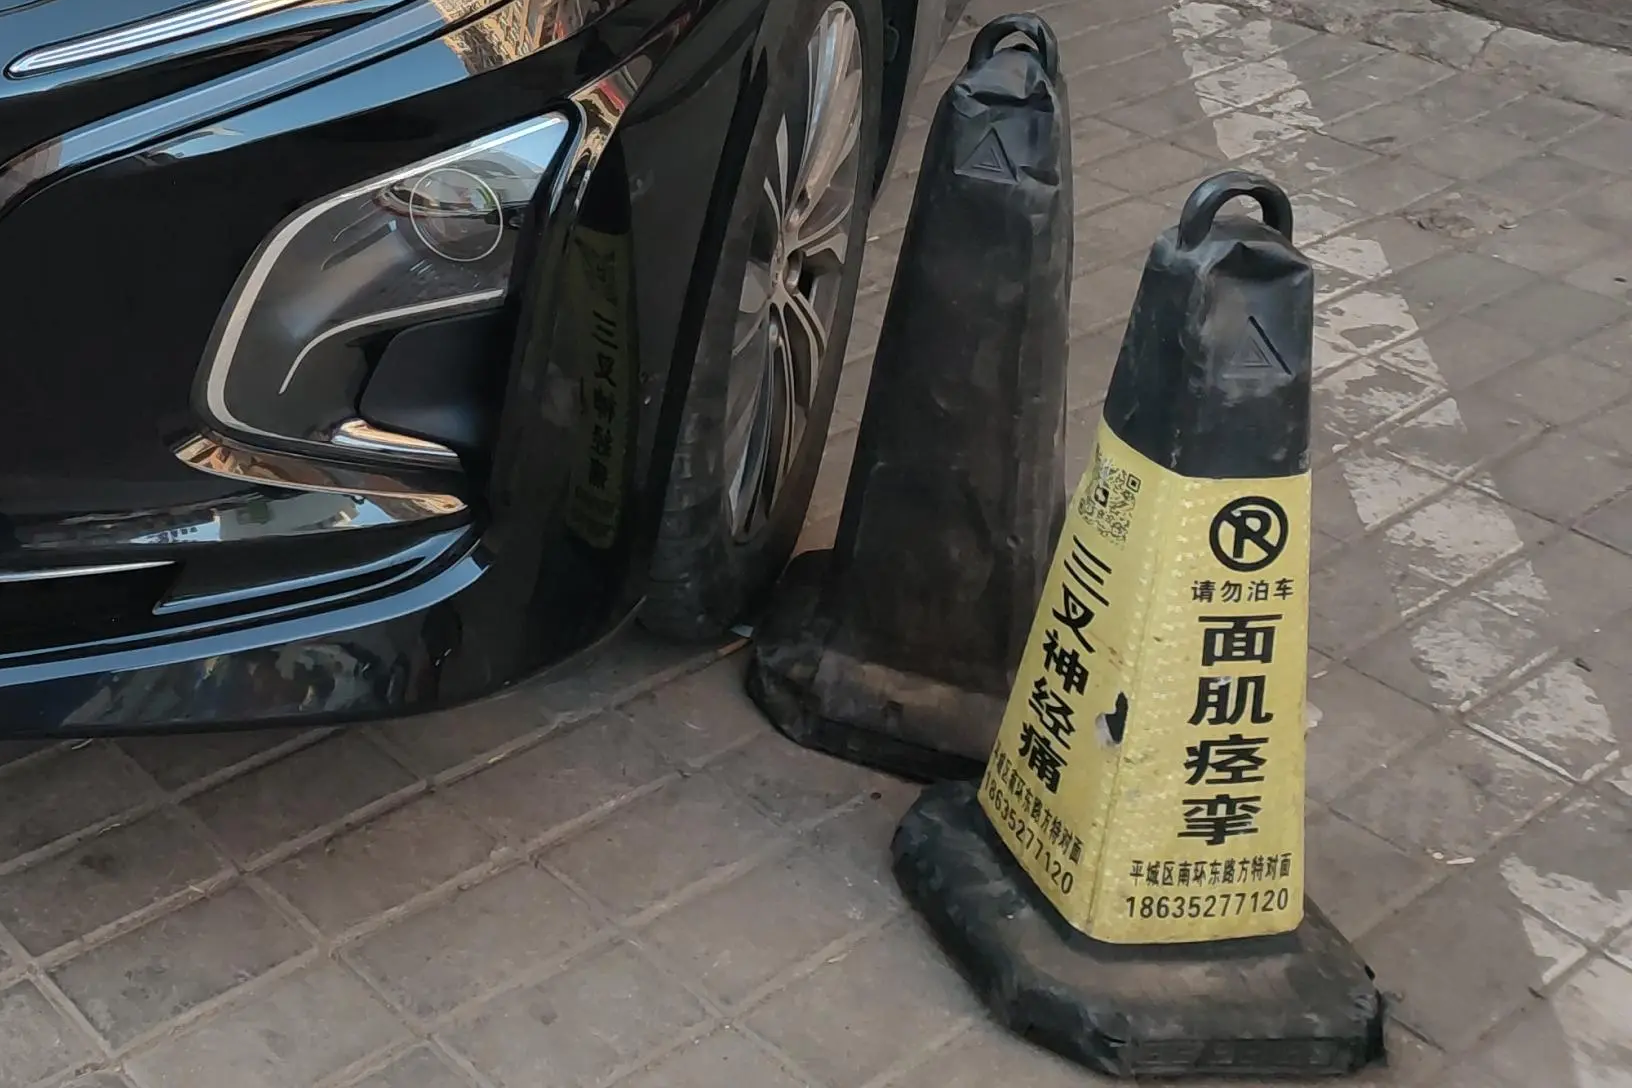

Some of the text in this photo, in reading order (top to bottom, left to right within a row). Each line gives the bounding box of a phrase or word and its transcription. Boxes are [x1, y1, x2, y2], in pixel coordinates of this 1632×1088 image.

[1190, 577, 1296, 604] 请勿泊车
[1018, 534, 1113, 794] 三叉神经痛
[1176, 612, 1284, 847] 面肌痉挛
[984, 770, 1074, 895] 18635277120
[1129, 852, 1293, 887] 平城区南环东路方特对面
[1125, 887, 1289, 919] 18635277120
